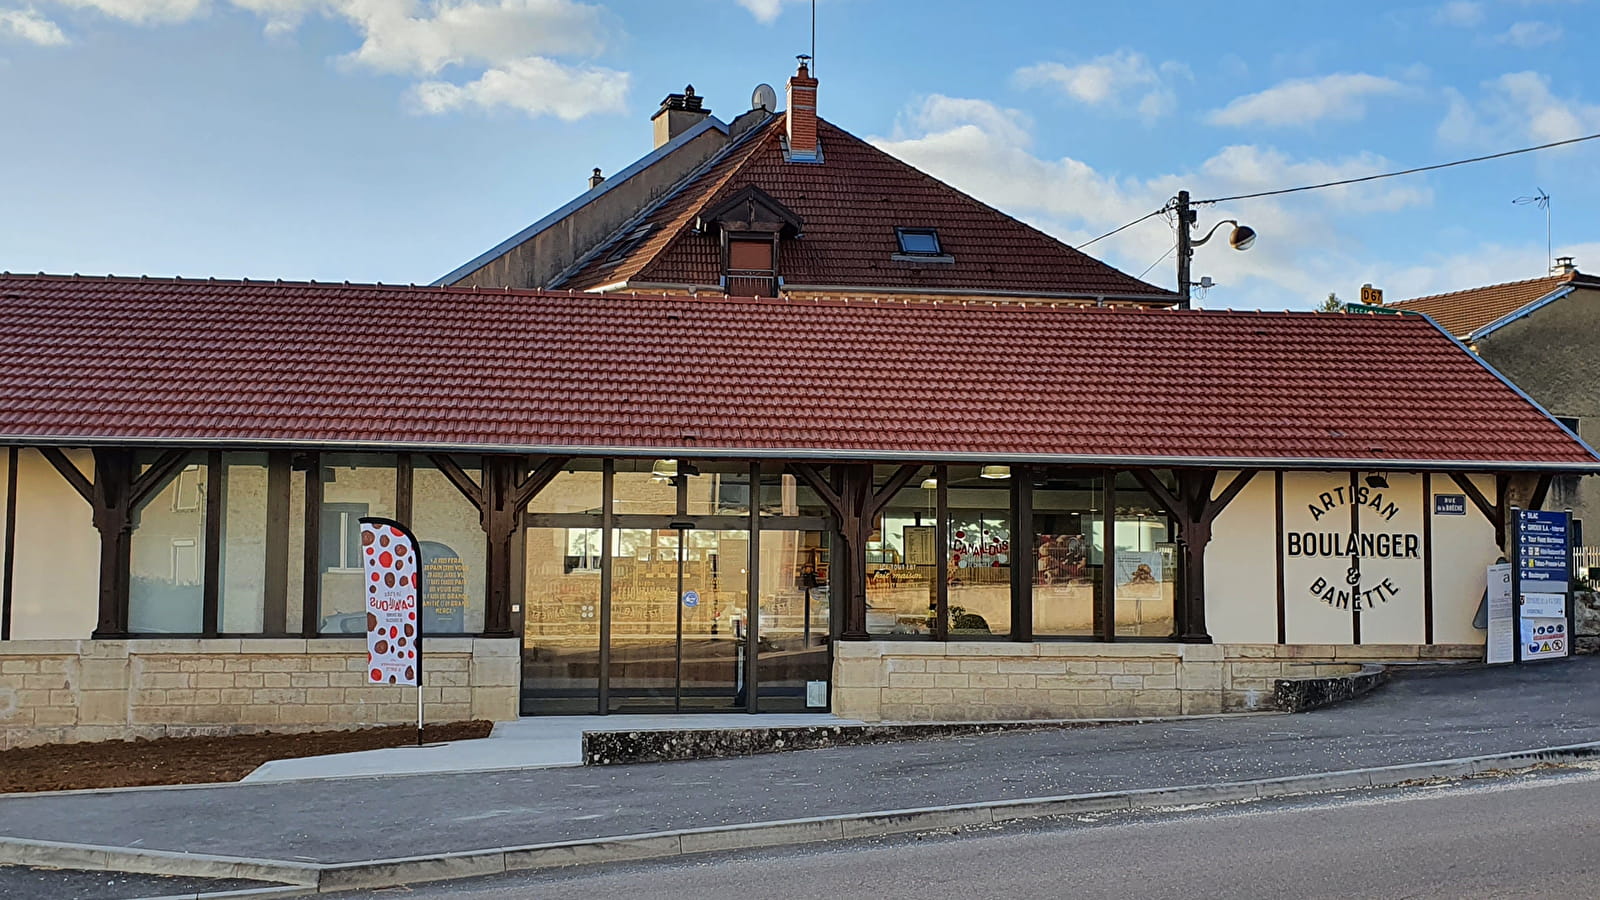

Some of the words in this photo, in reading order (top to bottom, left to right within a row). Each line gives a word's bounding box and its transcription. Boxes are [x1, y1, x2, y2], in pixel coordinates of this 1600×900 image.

[1363, 290, 1370, 300] D
[1371, 291, 1381, 302] 67
[1308, 486, 1399, 521] ARTISAN
[953, 539, 1009, 557] CANAILLOUS
[1287, 532, 1421, 558] BOULANGER
[873, 570, 890, 582] fait
[892, 571, 922, 579] maison
[1346, 567, 1360, 586] &
[1309, 577, 1400, 611] BANETTE
